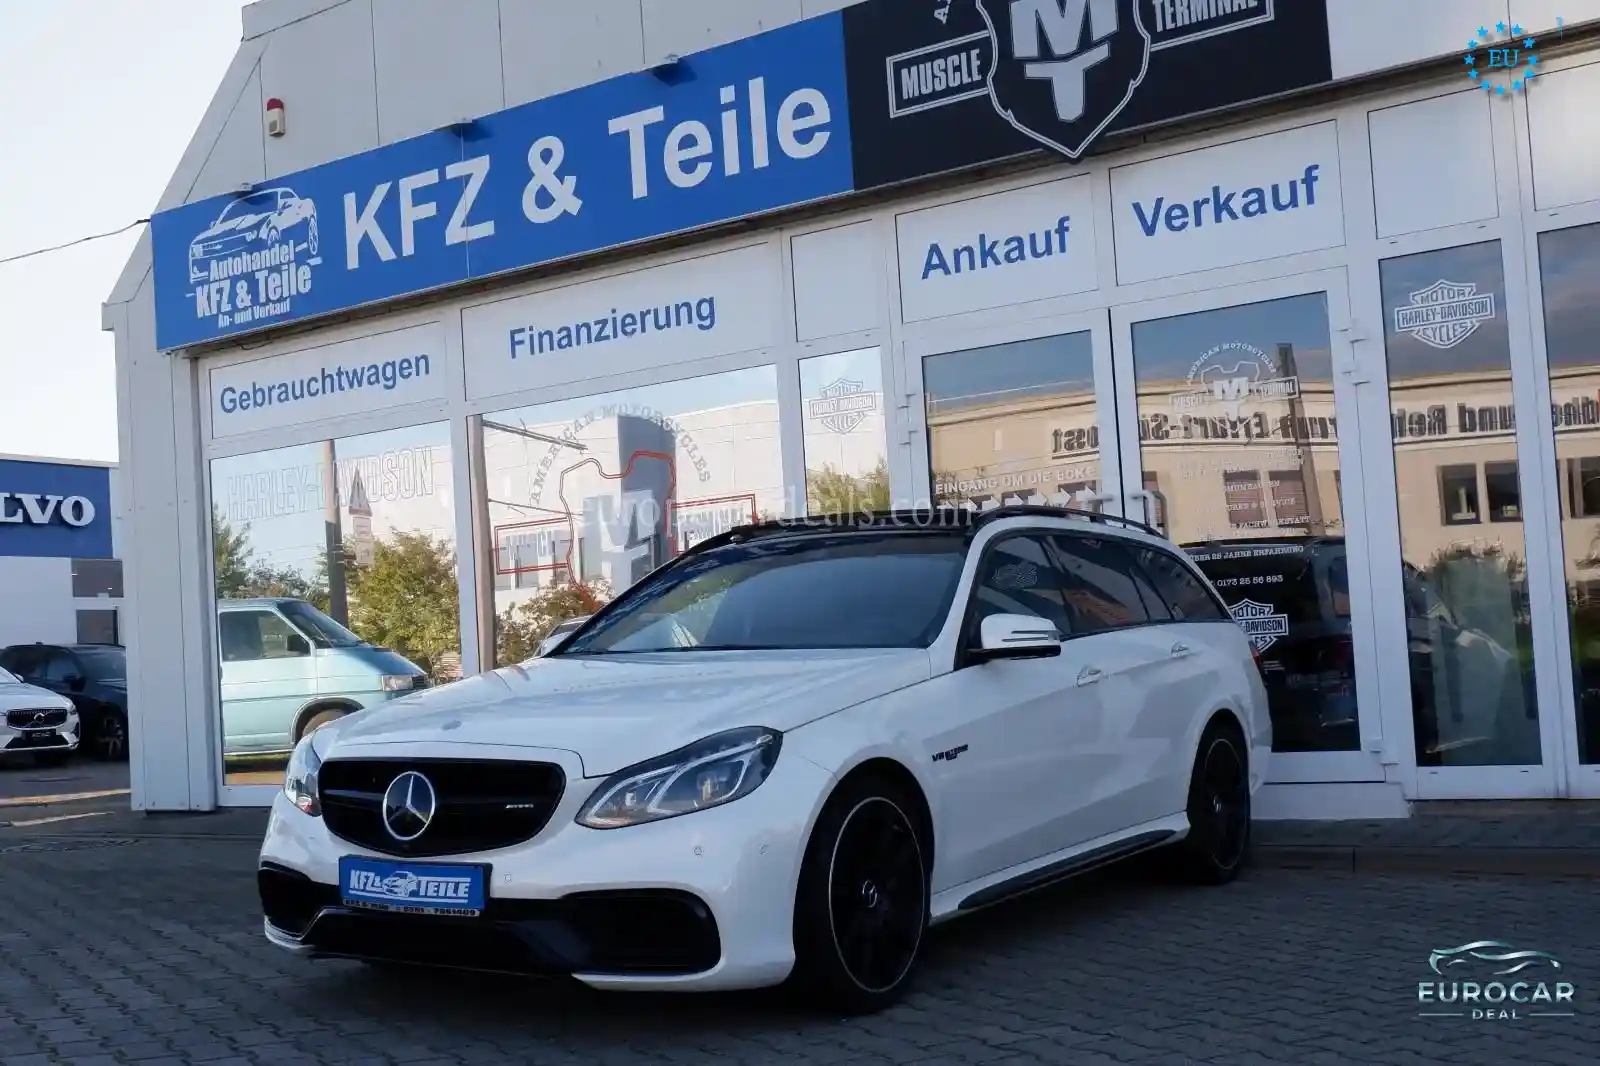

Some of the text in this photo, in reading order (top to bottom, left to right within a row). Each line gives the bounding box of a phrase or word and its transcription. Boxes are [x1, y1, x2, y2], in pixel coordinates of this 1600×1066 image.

[1153, 0, 1258, 32] TERMI
[901, 47, 981, 100] MUSCLE
[343, 76, 831, 270] KFZ & Teile
[1132, 164, 1320, 237] Verkauf
[210, 240, 295, 281] Autohandel
[921, 215, 1071, 280] Ankauf
[196, 262, 311, 318] KFZ & Teile
[1421, 288, 1466, 305] MOTOR
[509, 296, 715, 359] Finanzierung
[1401, 299, 1488, 326] HARLEY-DAVIDSON
[1422, 321, 1469, 342] CYCLES
[220, 354, 430, 413] Gebrauchtwagen
[935, 478, 999, 494] EINGANG
[0, 492, 96, 526] LVO
[1217, 578, 1237, 587] 0173
[419, 880, 470, 897] TEILE
